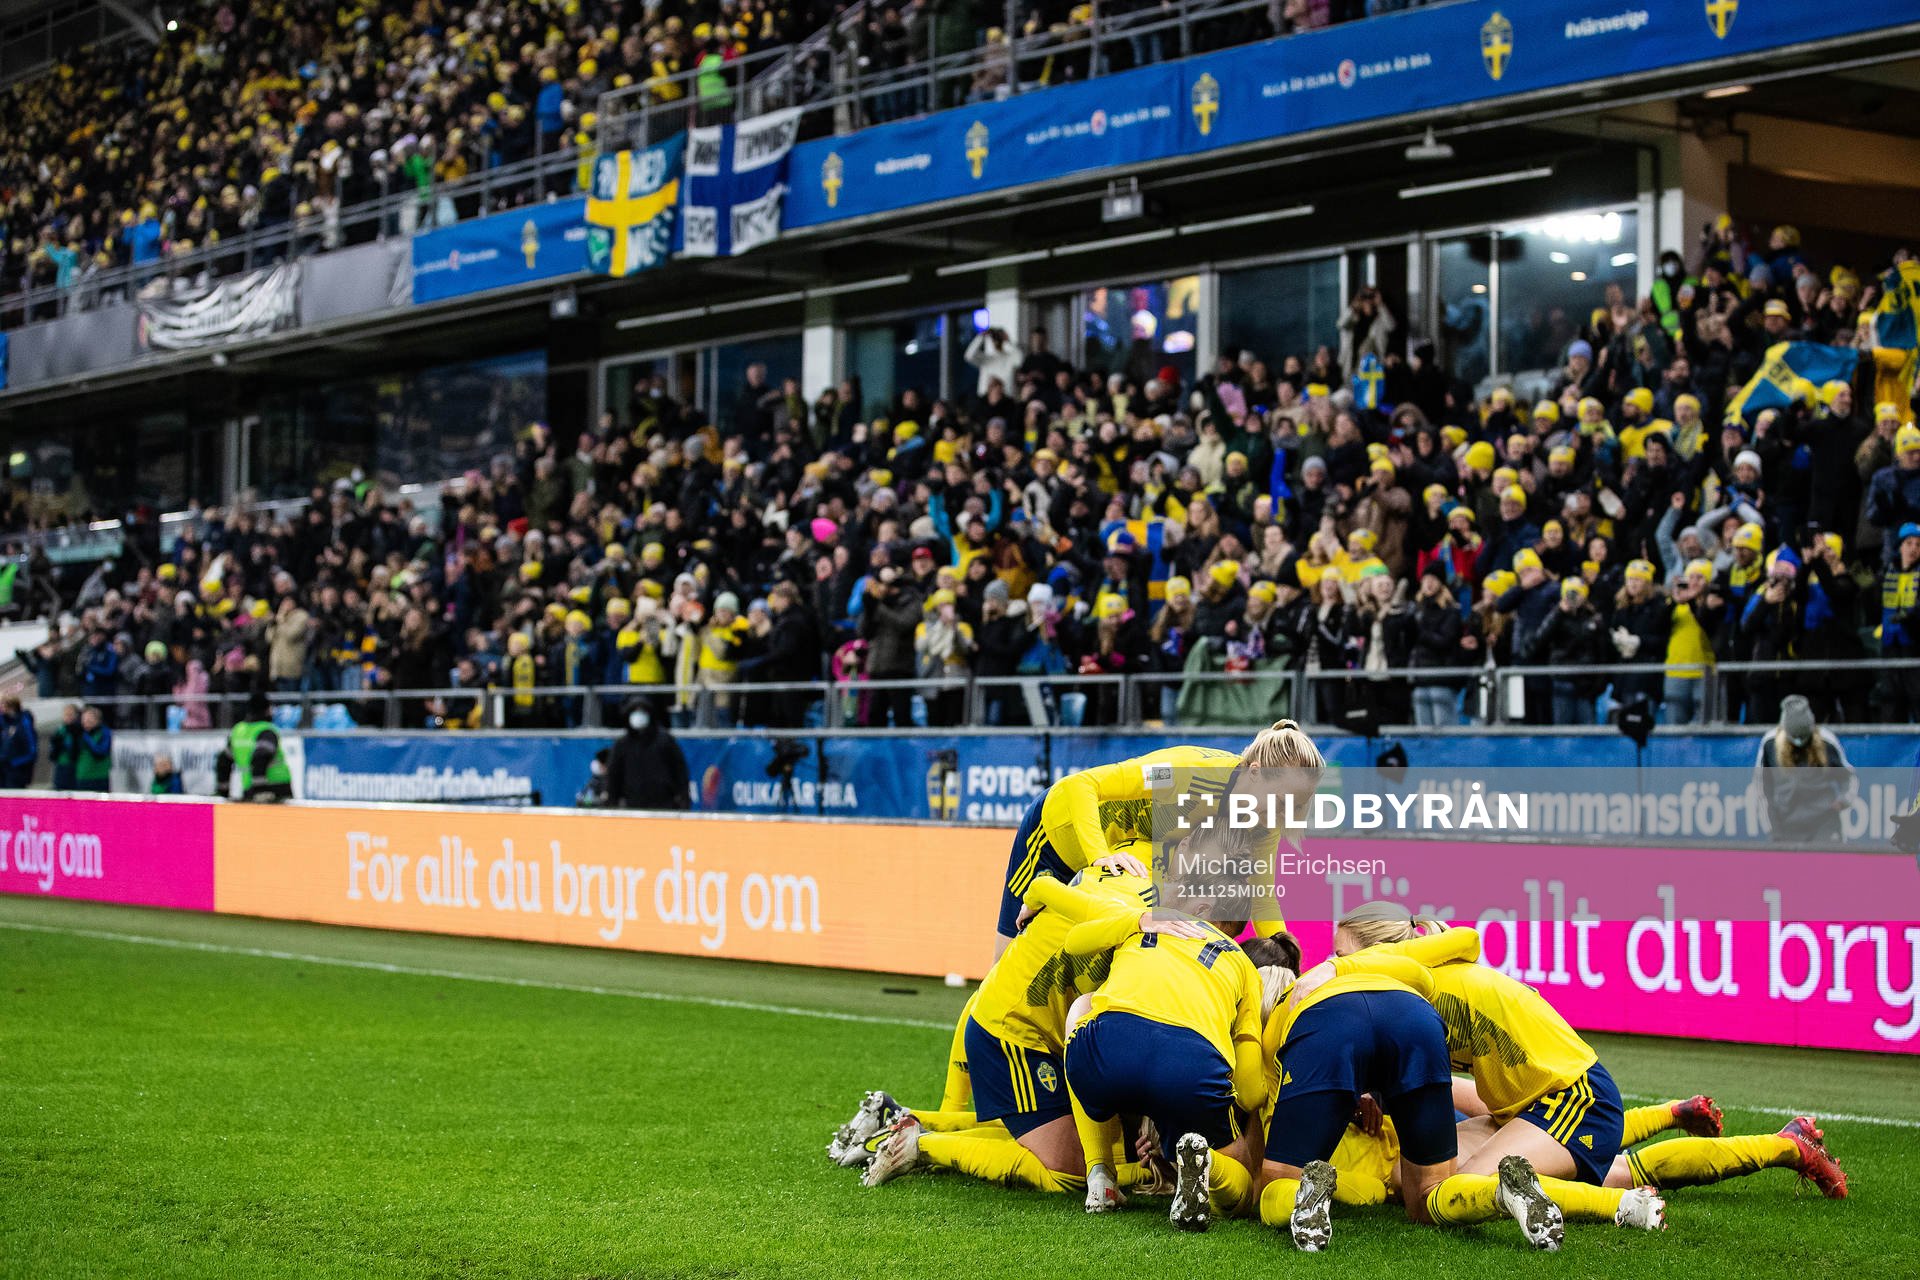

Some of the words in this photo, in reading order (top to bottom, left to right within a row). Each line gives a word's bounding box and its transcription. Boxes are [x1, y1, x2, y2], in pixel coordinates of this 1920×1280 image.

[14, 814, 56, 892] dig
[58, 832, 104, 878] om
[346, 831, 409, 902] För
[415, 834, 481, 910] allt
[488, 837, 542, 913] du
[550, 839, 646, 942] bryr
[654, 844, 729, 950] dig
[740, 872, 822, 933] om
[1474, 878, 1605, 989] allt
[1626, 884, 1739, 996] du
